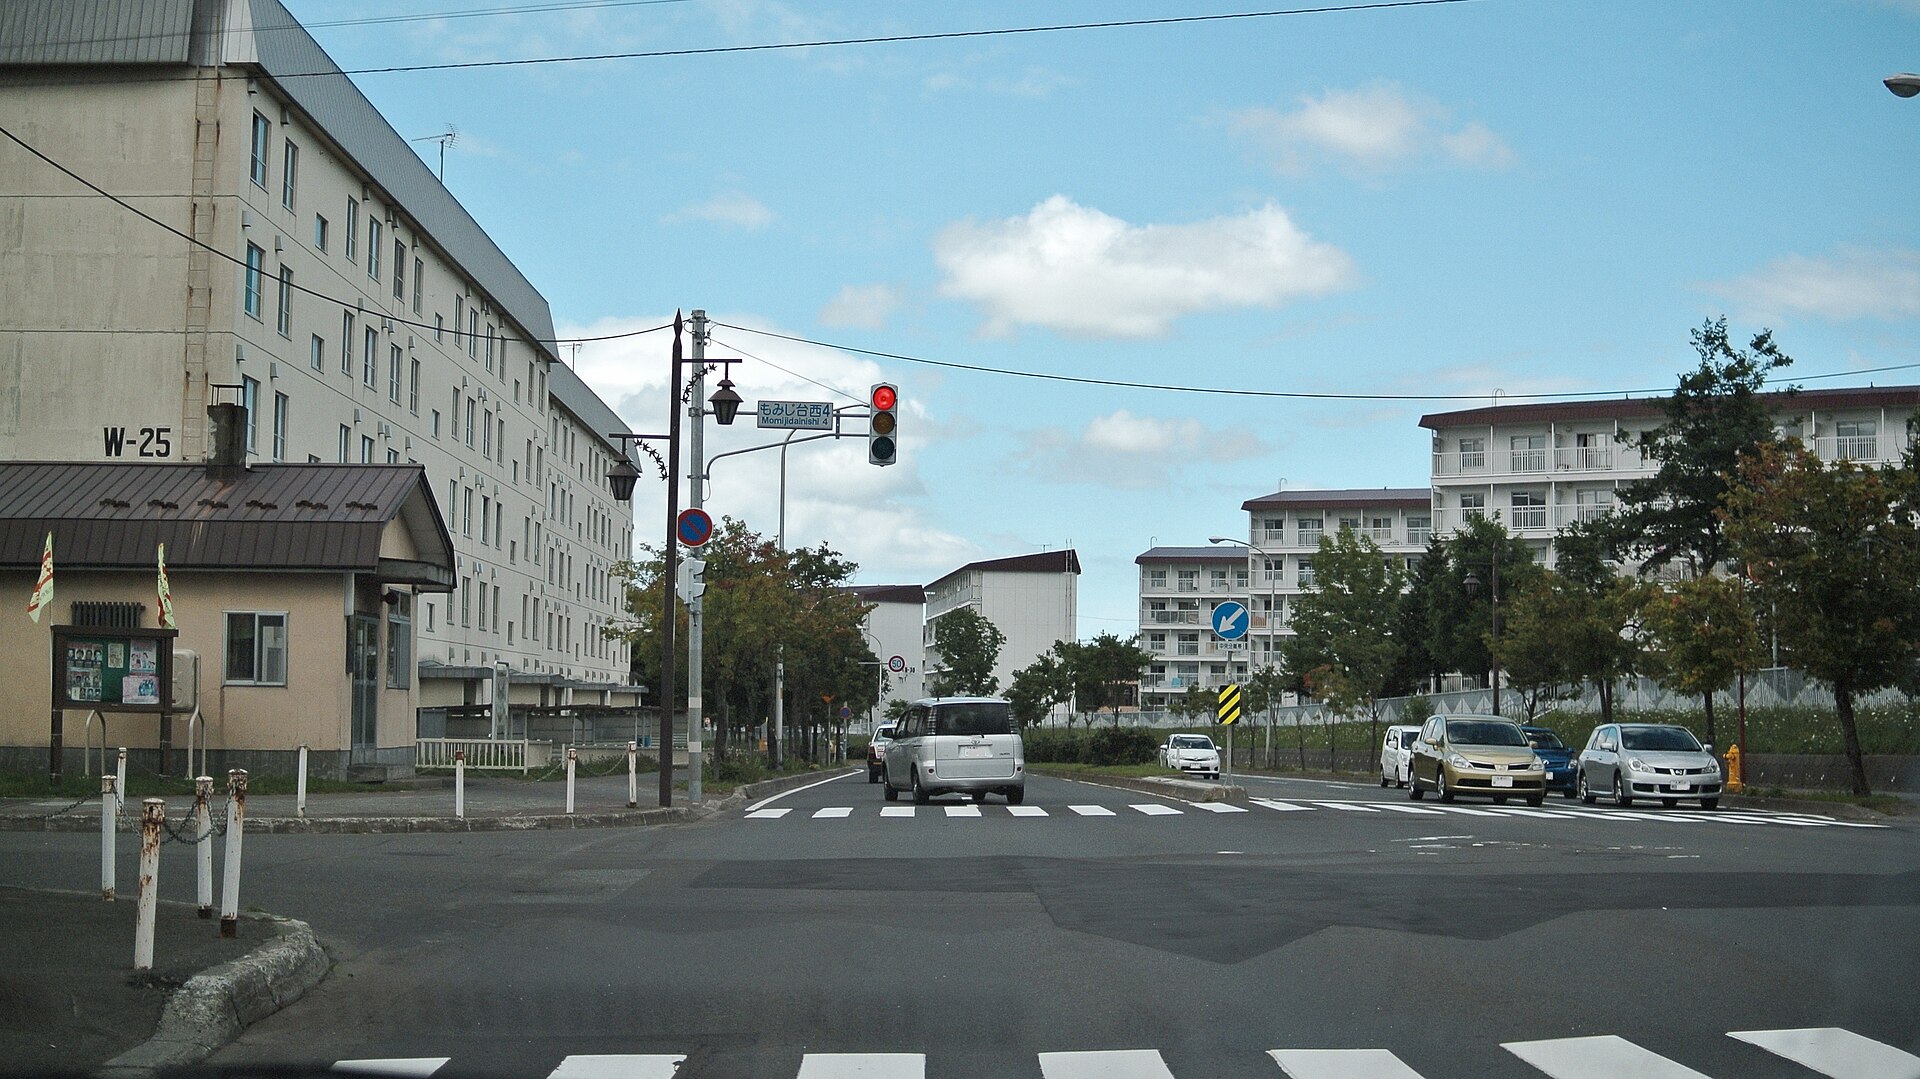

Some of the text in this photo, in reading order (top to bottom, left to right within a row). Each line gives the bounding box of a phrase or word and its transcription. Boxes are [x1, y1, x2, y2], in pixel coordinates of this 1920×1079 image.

[761, 403, 830, 417] もみじ台西4
[761, 417, 819, 426] Momijidainishi
[103, 427, 171, 457] W-25
[892, 660, 902, 668] 50
